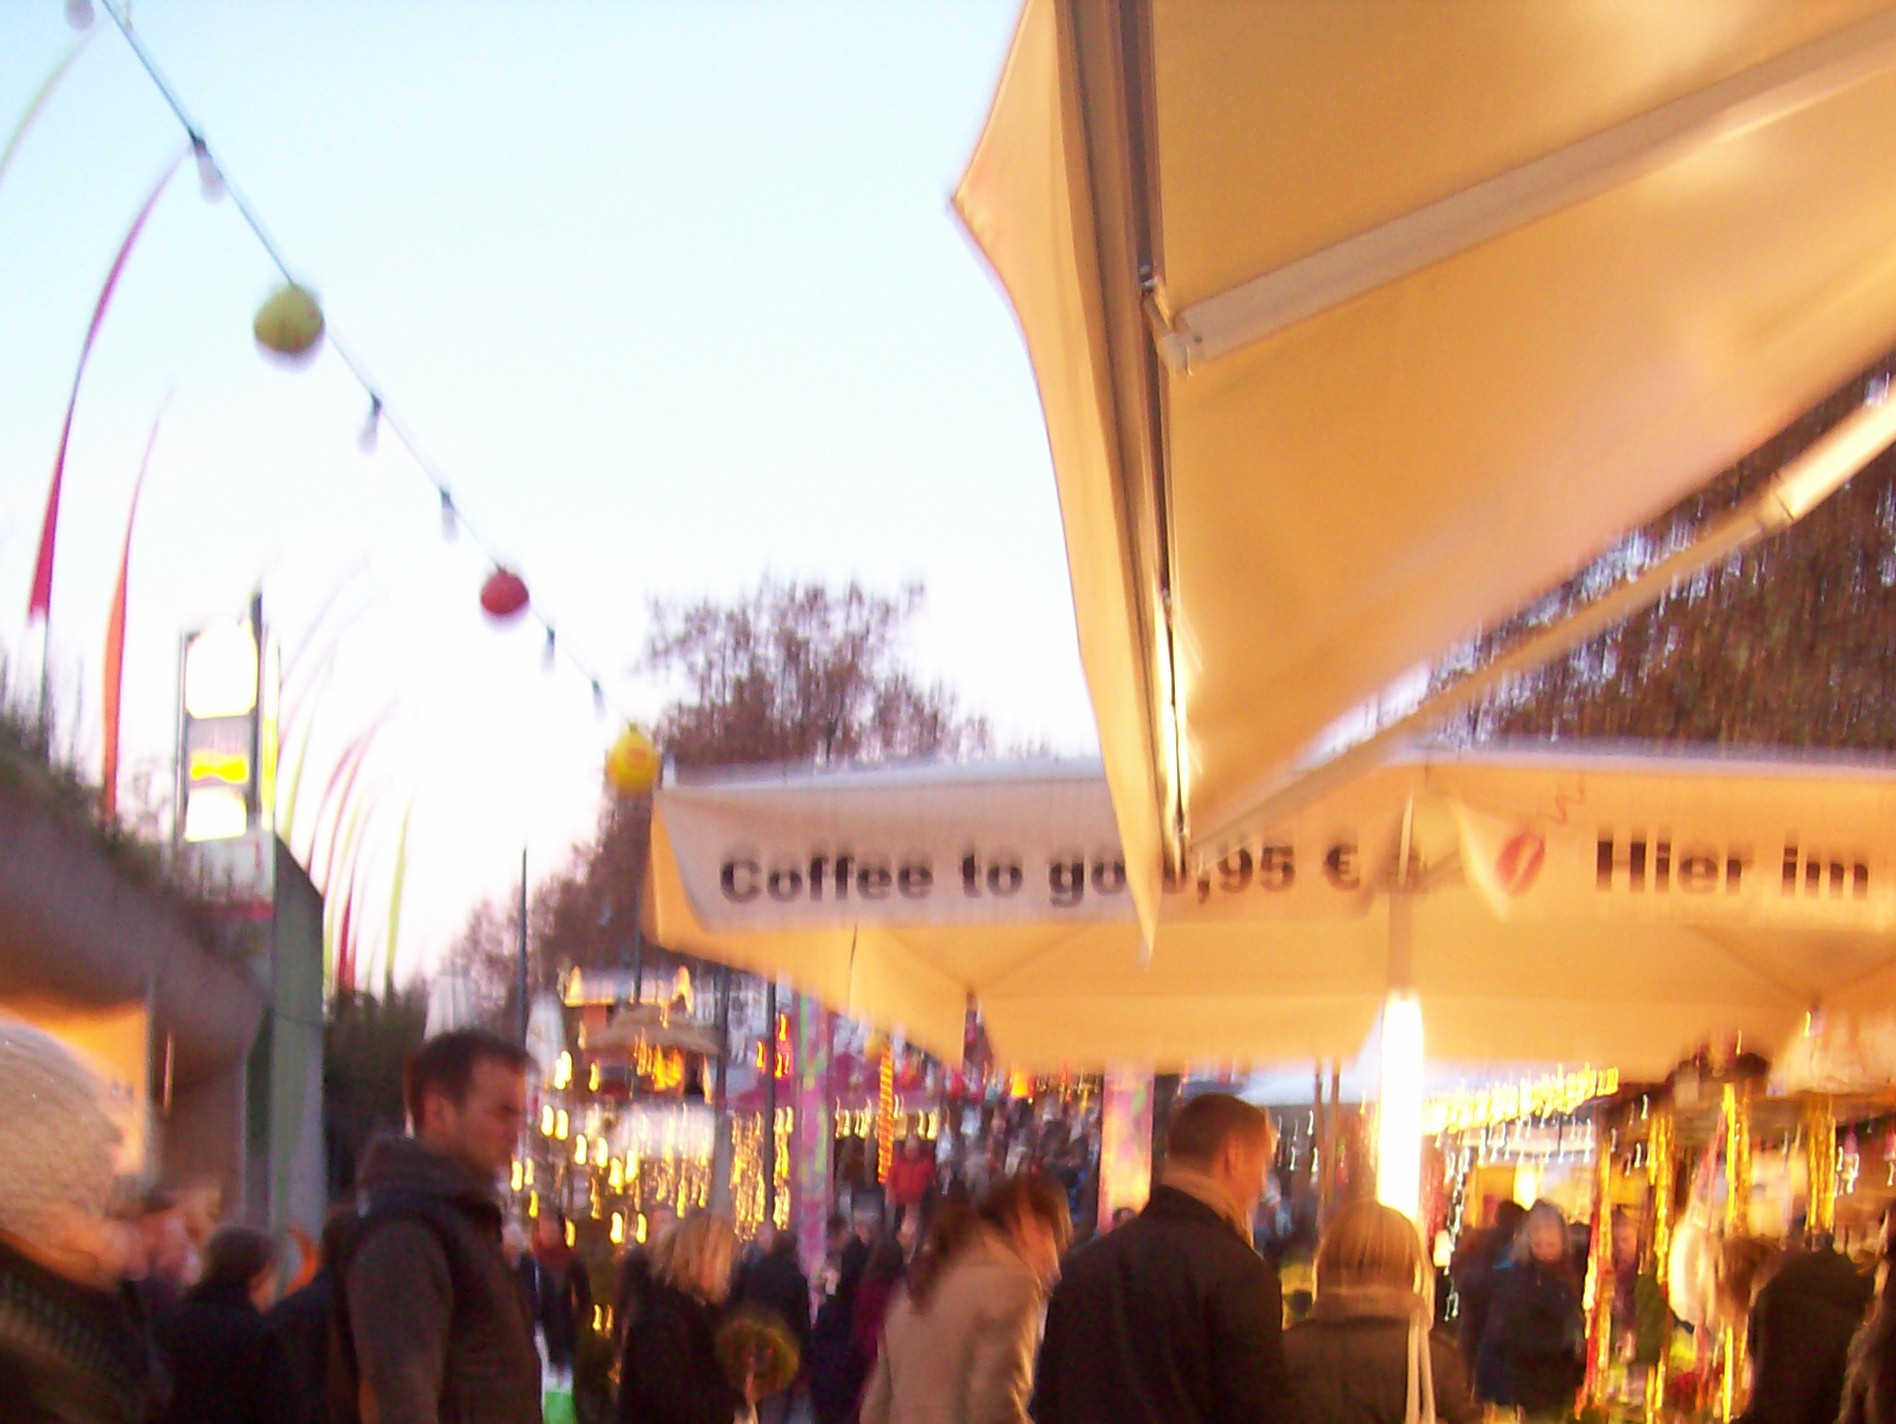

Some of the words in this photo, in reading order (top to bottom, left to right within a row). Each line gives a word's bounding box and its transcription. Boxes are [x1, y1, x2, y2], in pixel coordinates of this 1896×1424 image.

[718, 851, 934, 903] Coffee
[957, 848, 1024, 898] to
[1047, 856, 1127, 908] go
[1322, 840, 1362, 890] €
[1596, 834, 1753, 896] Hier
[1781, 841, 1870, 900] im
